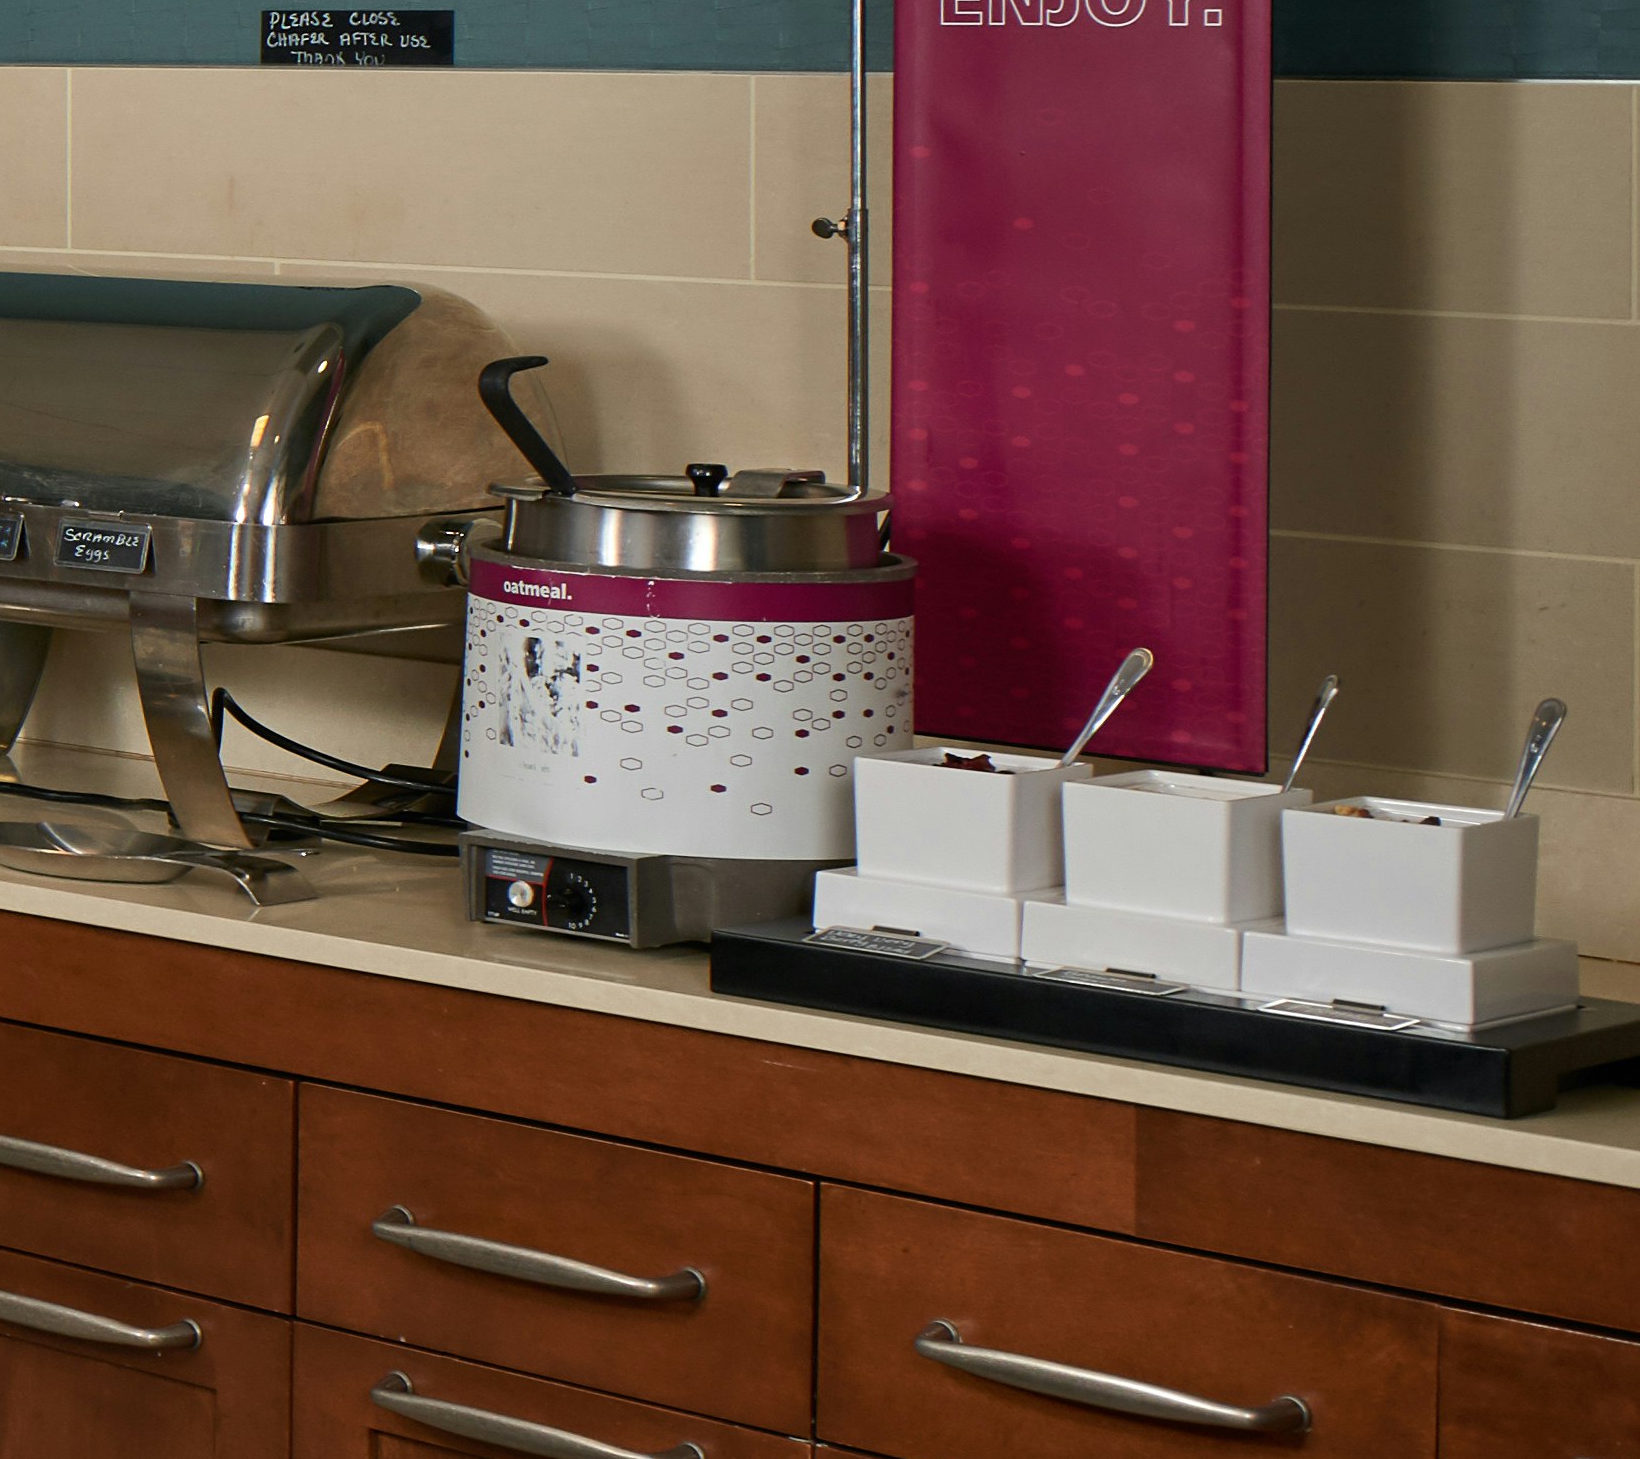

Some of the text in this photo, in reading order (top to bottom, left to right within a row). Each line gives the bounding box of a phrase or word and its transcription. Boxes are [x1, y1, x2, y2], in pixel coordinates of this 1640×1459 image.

[269, 11, 400, 30] PLEASE CLOSE
[267, 31, 431, 48] CHAFER AFTER USE
[503, 580, 573, 601] oatmeal.
